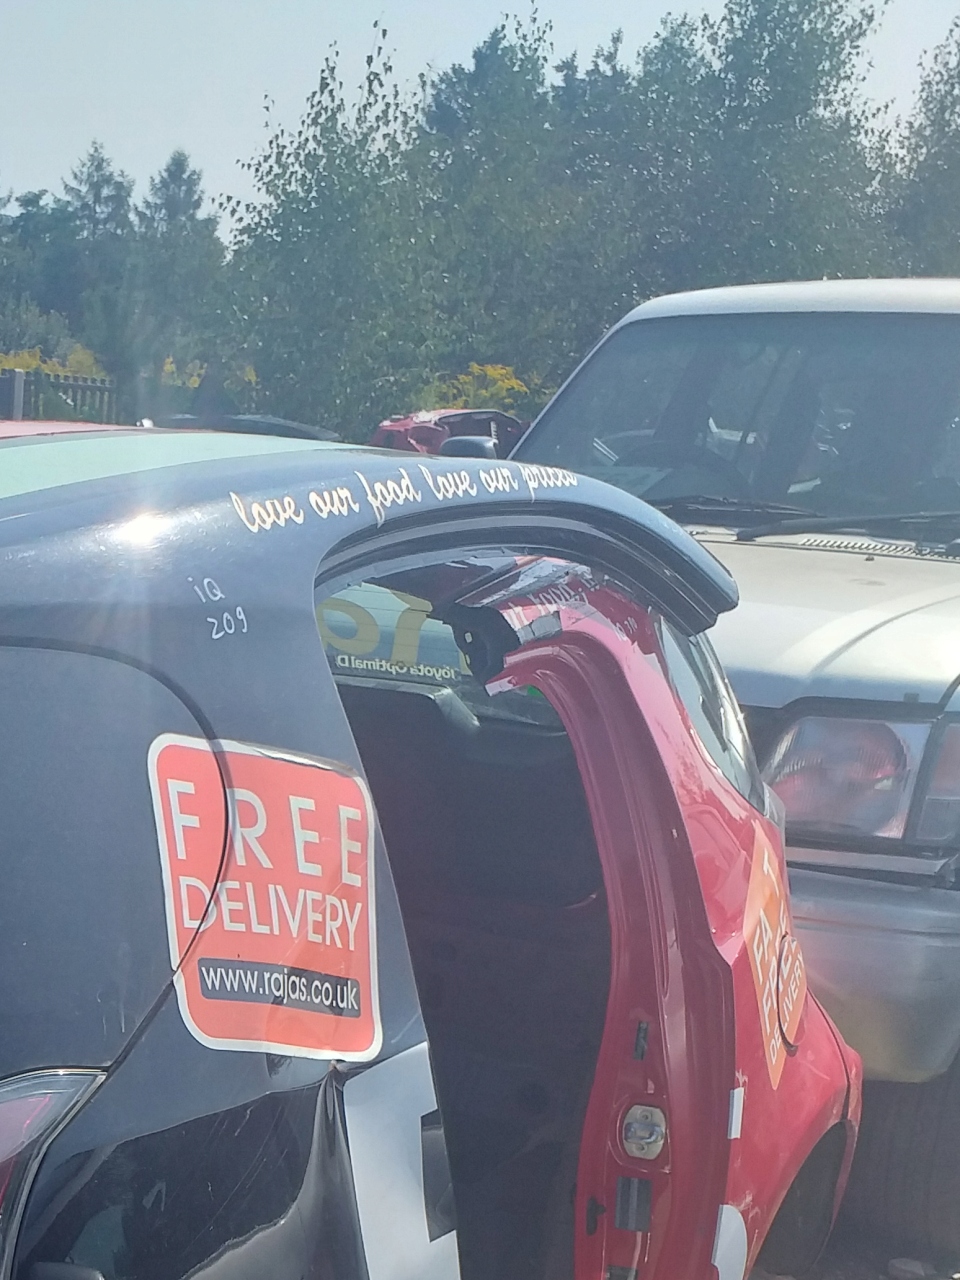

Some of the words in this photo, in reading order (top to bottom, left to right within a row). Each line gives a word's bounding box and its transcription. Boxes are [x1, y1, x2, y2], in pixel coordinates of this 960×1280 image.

[229, 491, 304, 533] love
[309, 487, 359, 519] our
[354, 470, 421, 528] food
[418, 463, 477, 500] love
[480, 466, 519, 493] our
[206, 606, 247, 639] 209
[167, 778, 362, 887] FREE
[179, 875, 362, 951] DELIVERY
[201, 966, 359, 1010] www.rajas.co.uk
